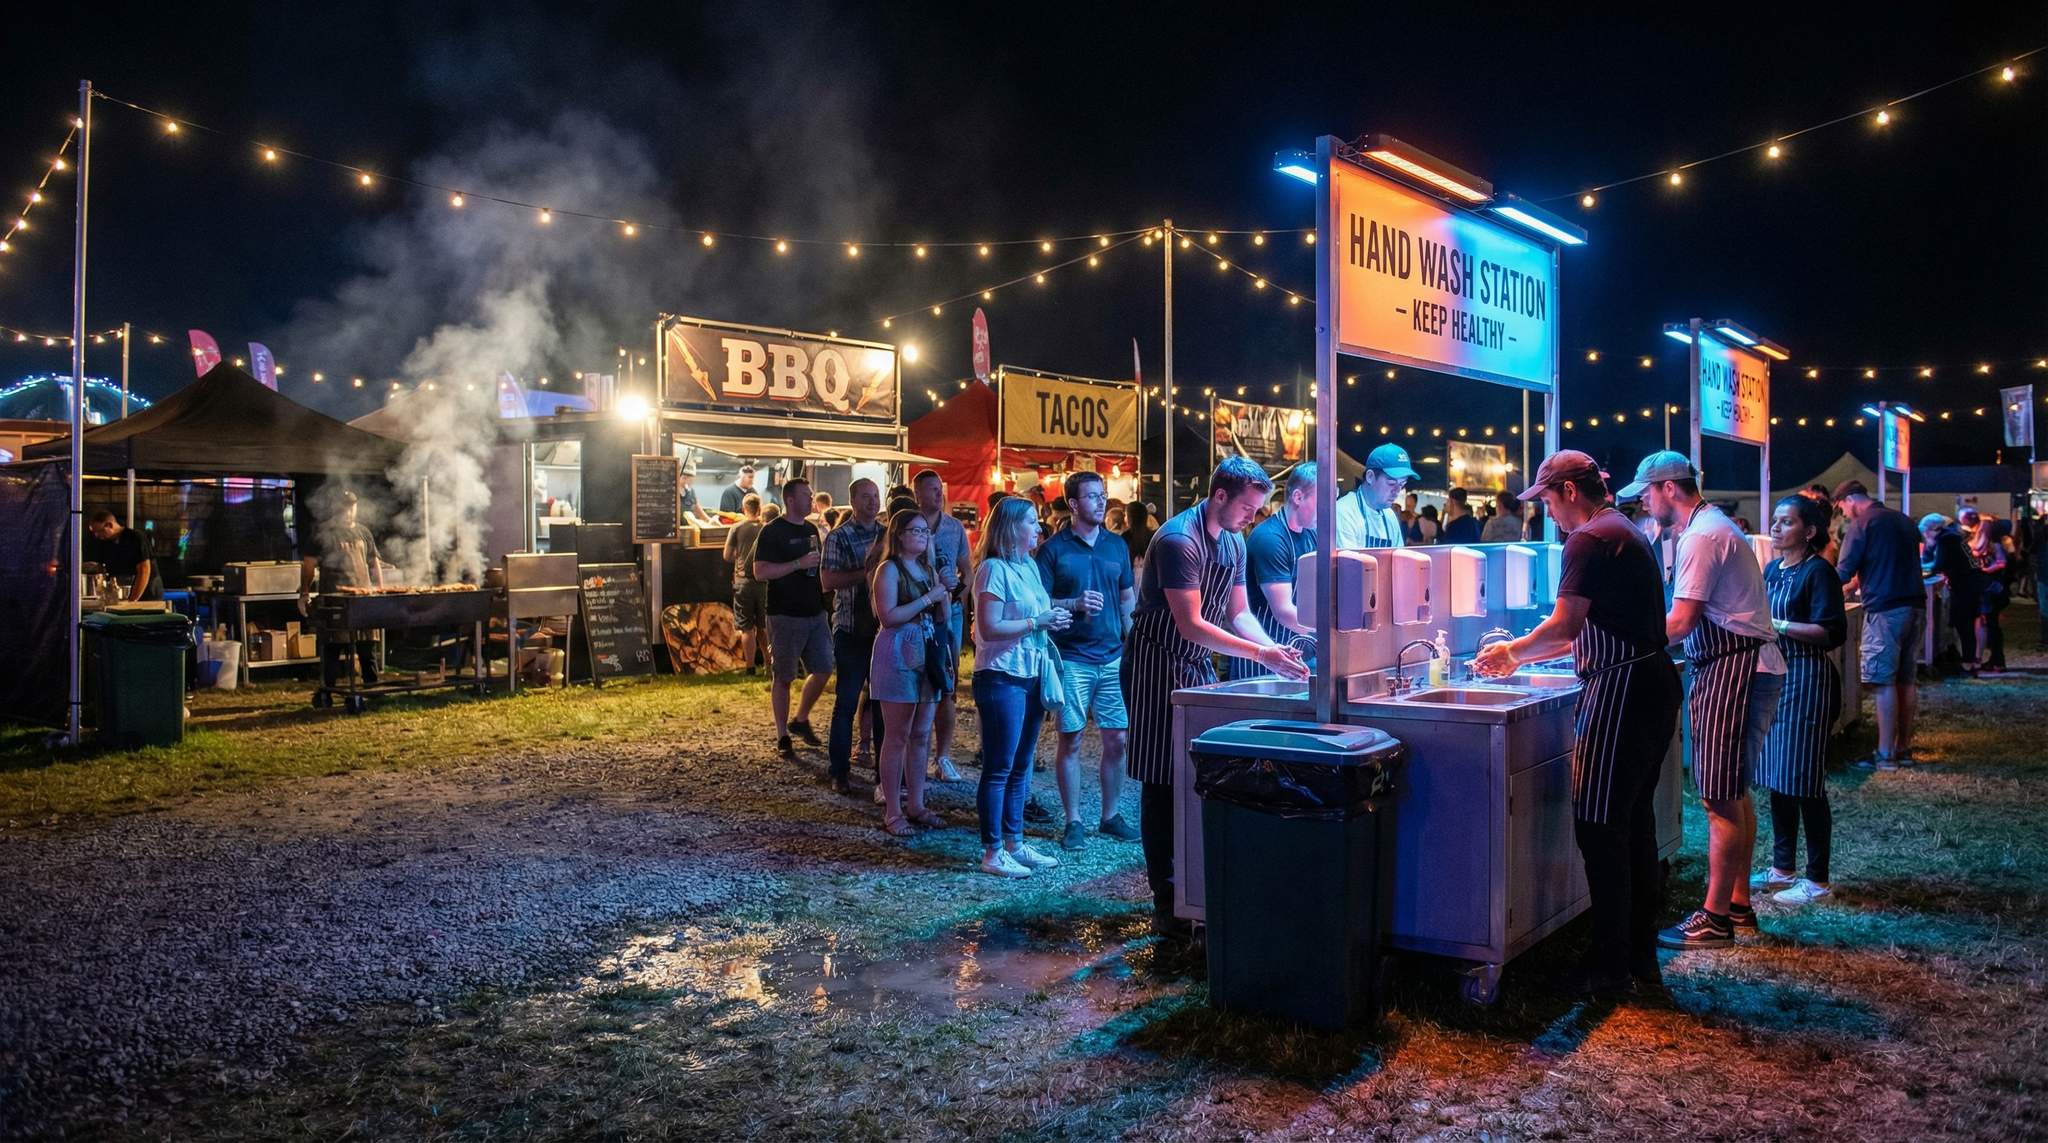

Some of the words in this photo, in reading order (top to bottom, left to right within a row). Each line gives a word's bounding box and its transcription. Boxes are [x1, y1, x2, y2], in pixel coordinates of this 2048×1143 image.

[1350, 213, 1411, 280] HAND
[1418, 236, 1474, 300] WASH
[1480, 260, 1546, 320] STATION
[1412, 298, 1448, 337] KEEP
[1451, 308, 1505, 351] HEALTHY
[722, 338, 850, 412] BBQ
[1702, 357, 1721, 391] HAND
[1036, 391, 1109, 439] TACOS
